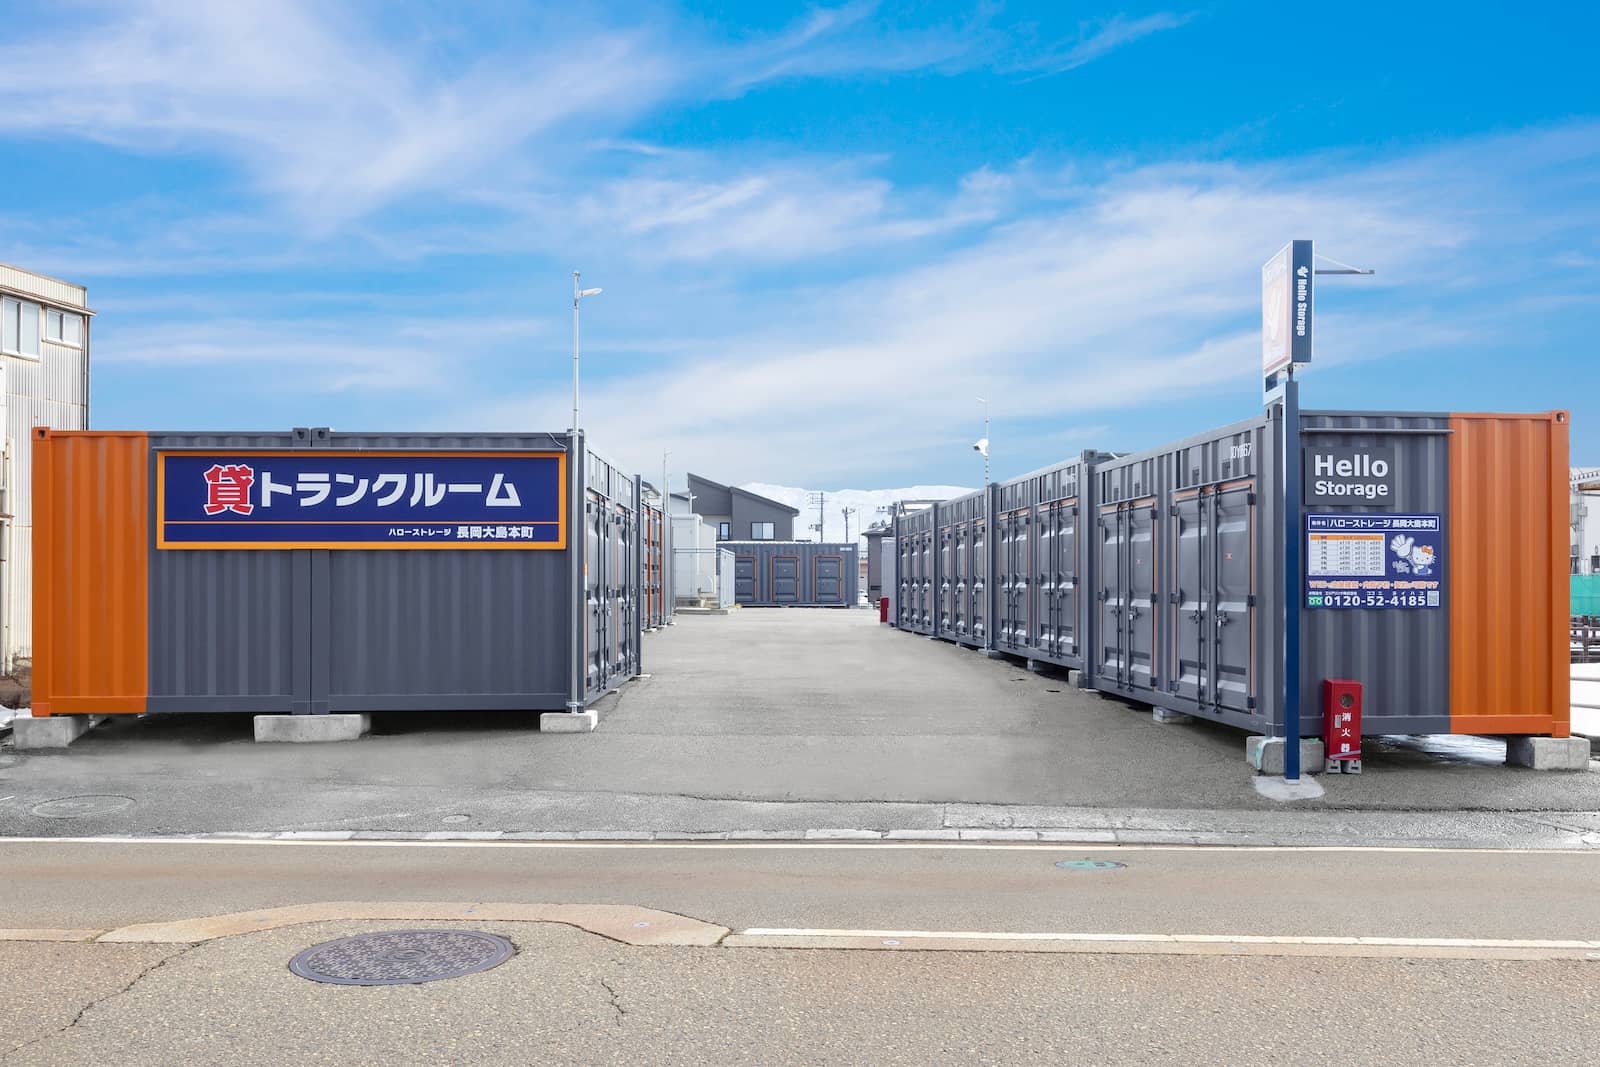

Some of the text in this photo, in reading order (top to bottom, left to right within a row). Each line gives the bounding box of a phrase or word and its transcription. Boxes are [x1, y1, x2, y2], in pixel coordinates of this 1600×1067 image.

[1296, 279, 1307, 336] Hello Storage
[1314, 454, 1389, 477] Hello
[203, 464, 522, 515] 貸トランクルーム
[1314, 480, 1389, 500] Storage
[388, 526, 535, 539] ハローストレージ 長岡大島本町
[1330, 519, 1391, 529] ハローストレージ
[1324, 595, 1426, 607] 0120-52-4185
